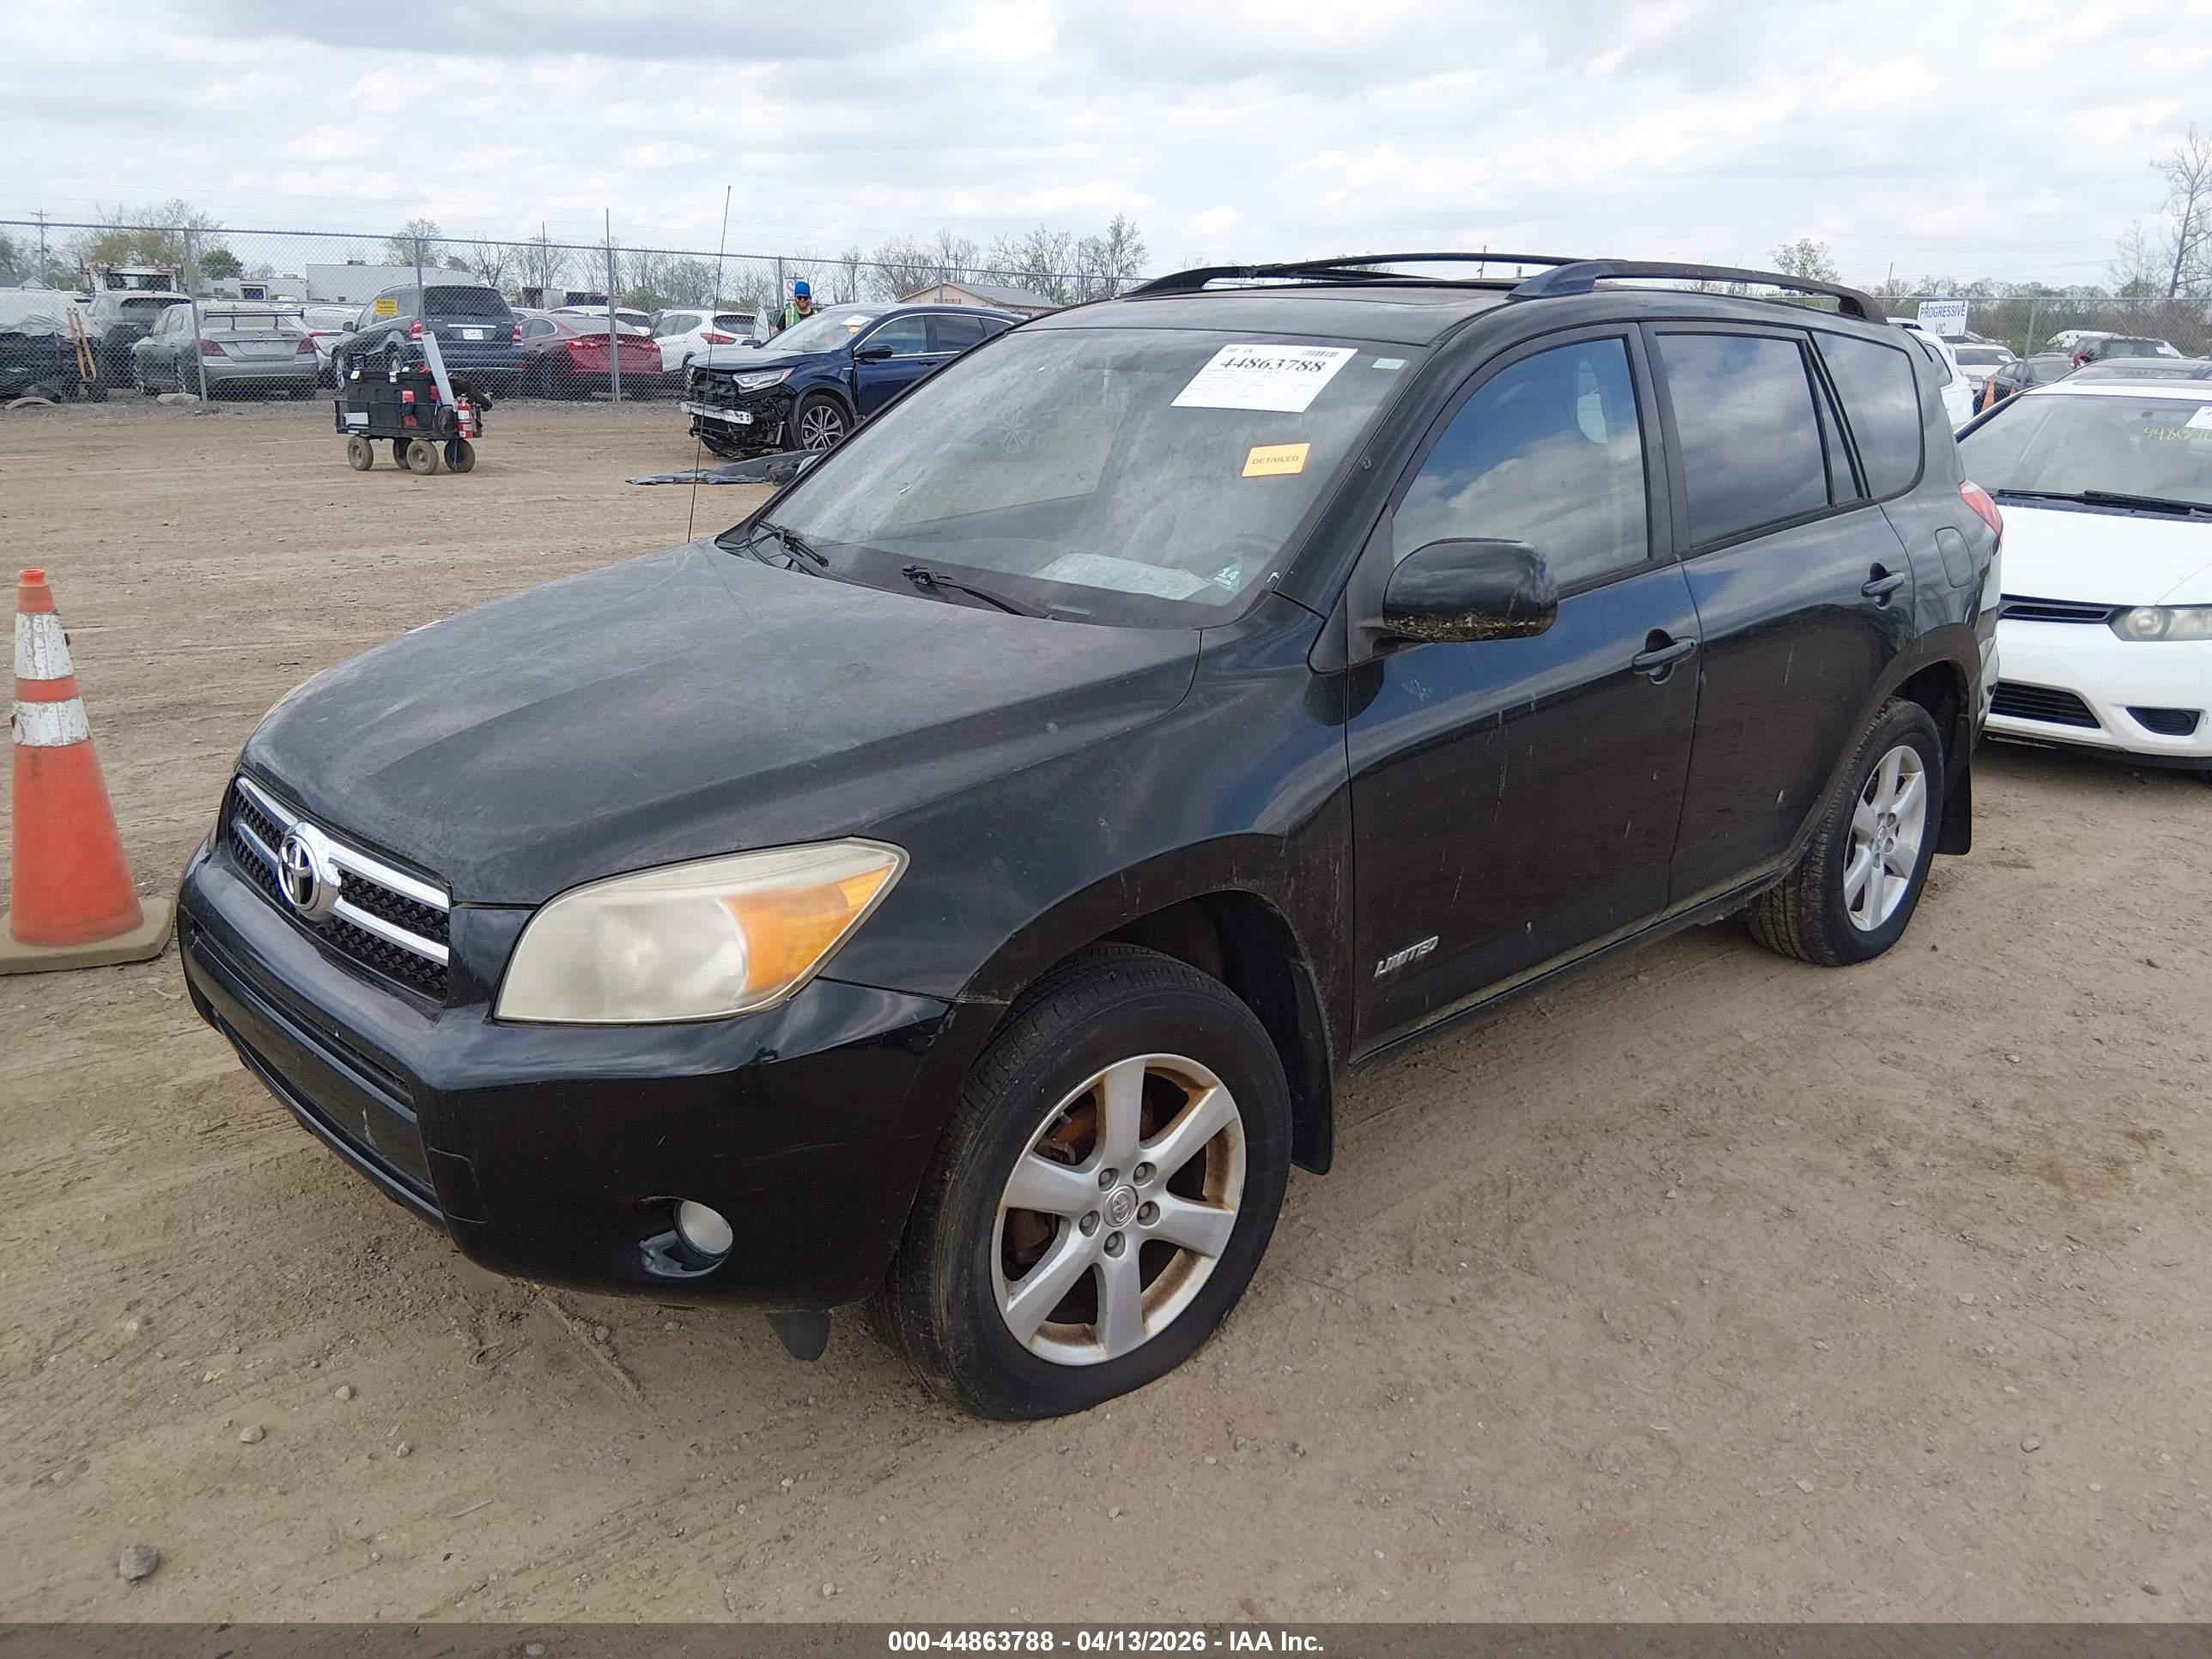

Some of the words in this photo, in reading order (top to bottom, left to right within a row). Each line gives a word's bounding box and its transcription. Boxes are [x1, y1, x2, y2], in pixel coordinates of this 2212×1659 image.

[1920, 305, 1965, 319] PROGRESSIVE
[1936, 323, 1946, 335] VIC
[1219, 356, 1327, 373] 44863788
[1252, 456, 1299, 465] DETAILED
[1374, 935, 1439, 977] LIMITED
